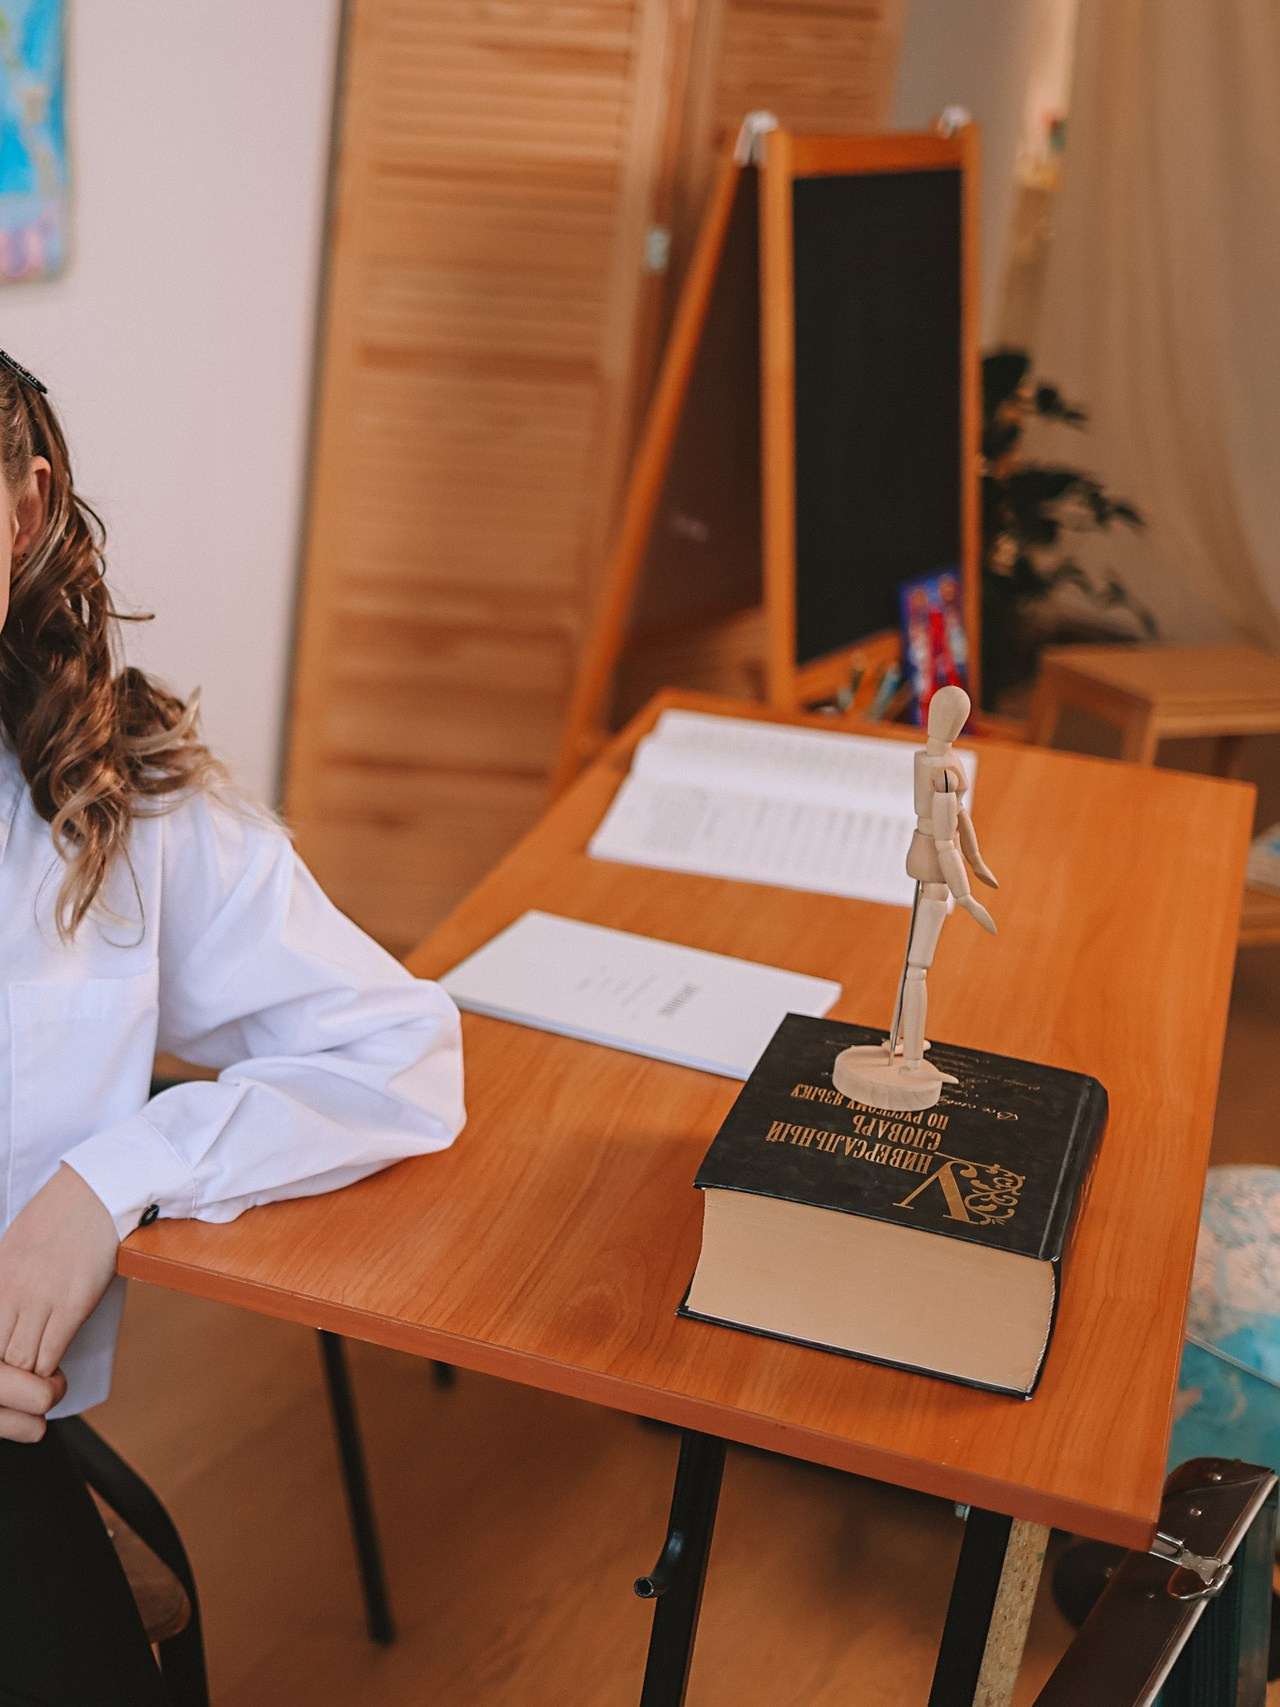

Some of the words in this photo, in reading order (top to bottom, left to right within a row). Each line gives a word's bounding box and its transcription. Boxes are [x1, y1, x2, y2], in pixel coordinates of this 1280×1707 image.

[789, 1083, 845, 1106] ЯЗЫКУ
[852, 1114, 942, 1151] СЛОВАРЬ
[927, 1112, 950, 1131] ПО
[764, 1120, 978, 1225] УНИВЕРСАЛЬНЫЙ
